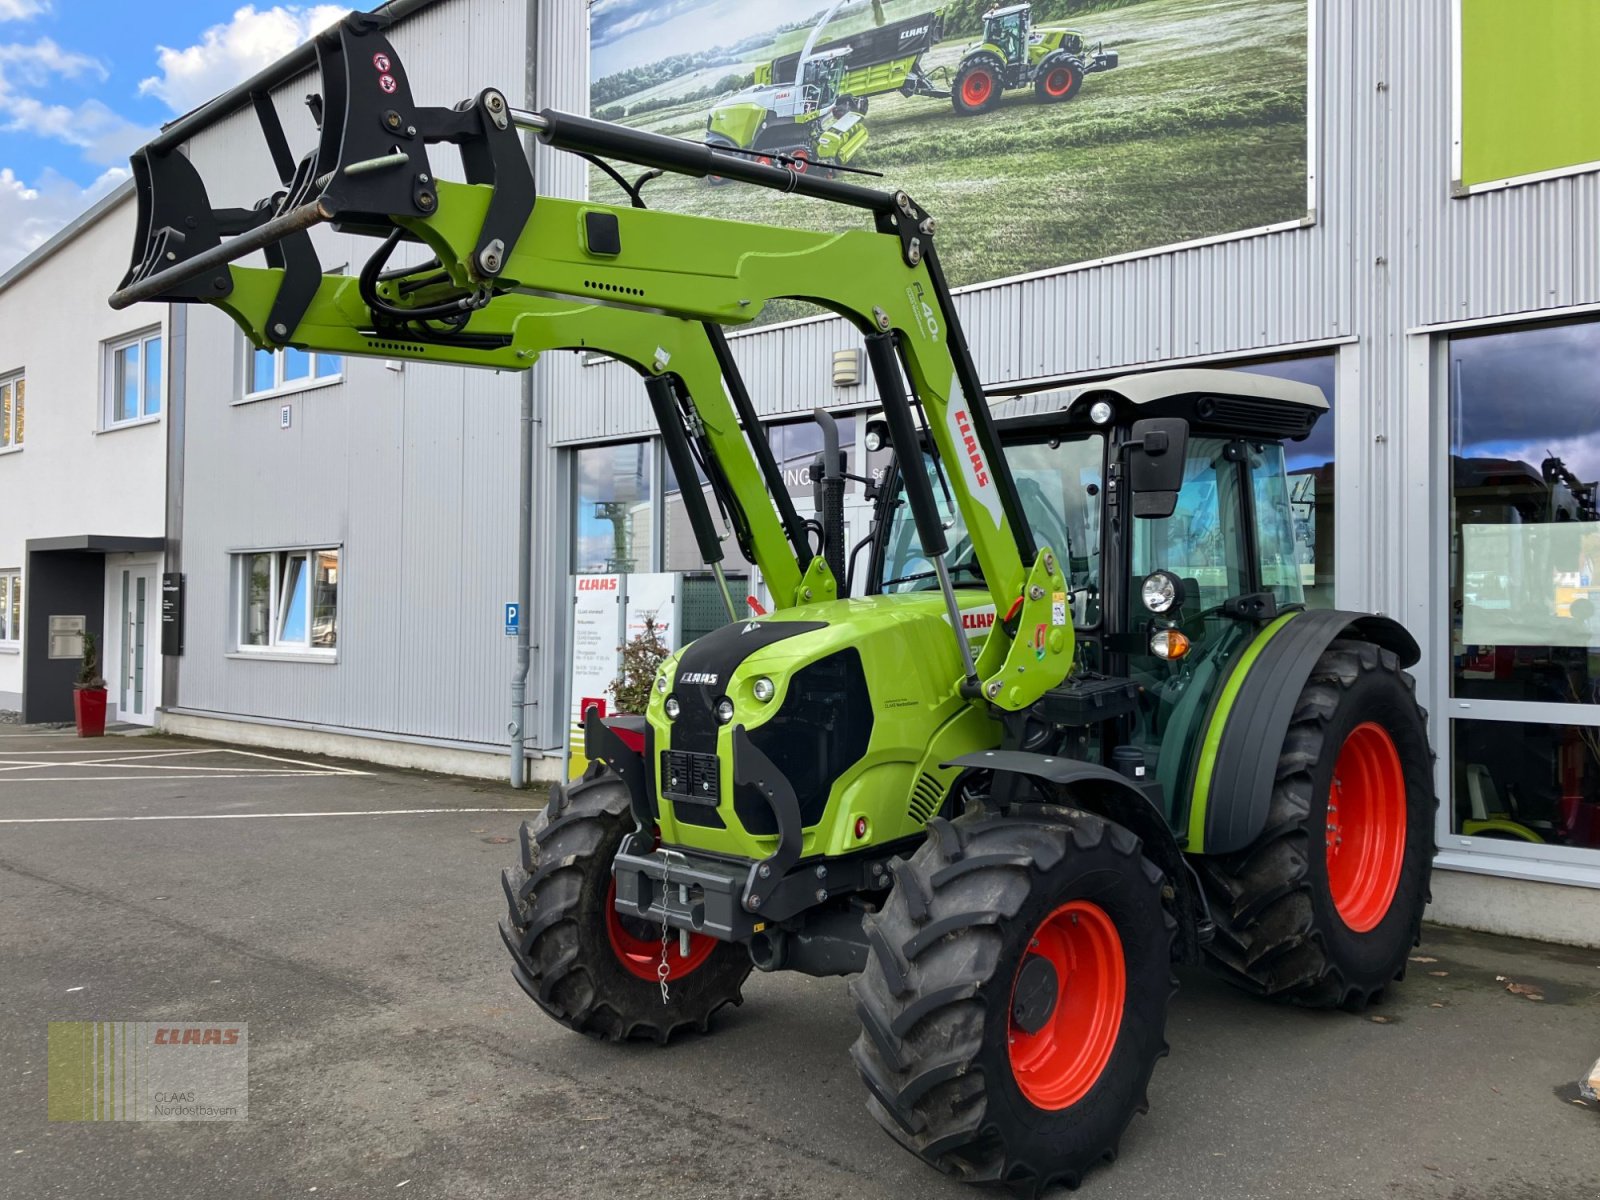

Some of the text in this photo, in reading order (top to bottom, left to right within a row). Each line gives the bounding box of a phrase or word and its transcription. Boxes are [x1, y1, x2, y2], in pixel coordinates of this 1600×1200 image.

[900, 25, 929, 40] CLAAS
[954, 410, 989, 488] CLAAS
[578, 578, 617, 591] CLAAS
[508, 607, 516, 624] P
[680, 672, 719, 686] CLAAS
